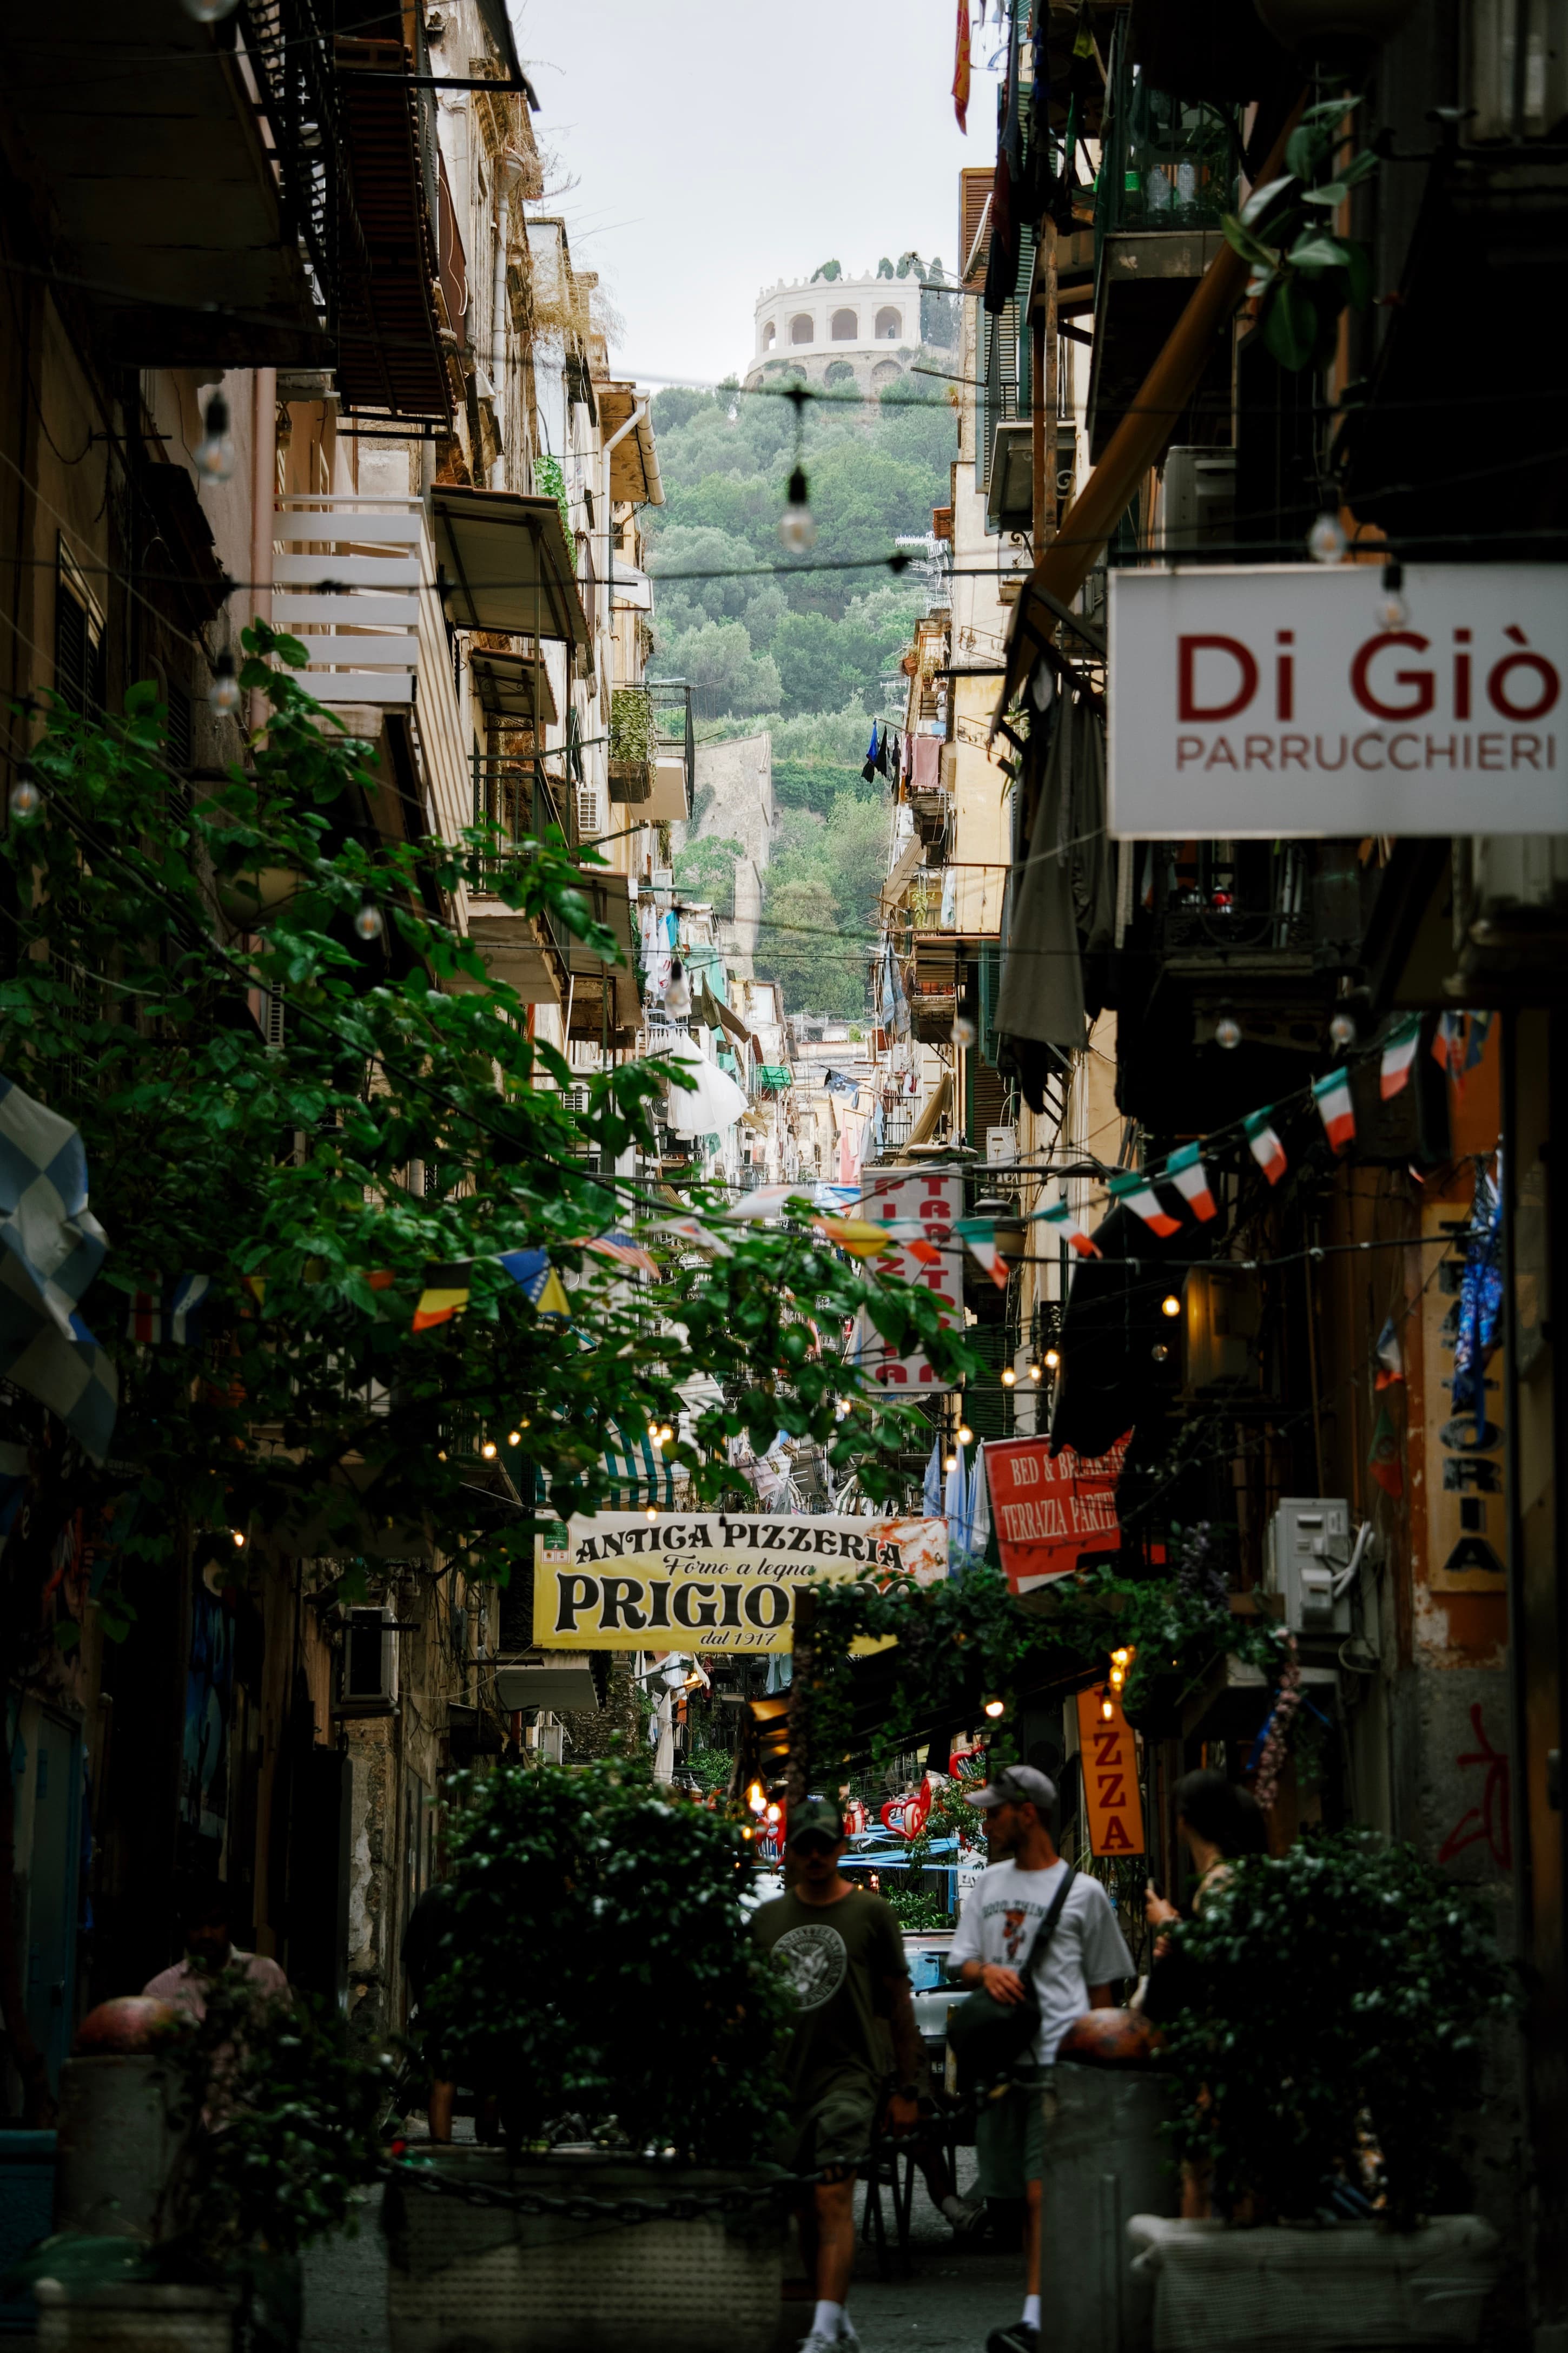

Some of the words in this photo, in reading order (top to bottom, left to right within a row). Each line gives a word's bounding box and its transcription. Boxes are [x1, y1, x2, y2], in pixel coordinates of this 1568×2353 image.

[1177, 630, 1294, 722] Di
[1350, 624, 1560, 721] Giò
[1176, 733, 1556, 772] PARRUCCHIERI
[1010, 1455, 1039, 1486] BED
[1043, 1454, 1056, 1482] &
[1001, 1498, 1068, 1542] TERRAZZA
[576, 1523, 713, 1565] ANTICA
[725, 1523, 905, 1571] PIZZERIA
[663, 1553, 733, 1576] Forno
[736, 1562, 752, 1575] a
[756, 1557, 816, 1583] legna
[700, 1630, 730, 1645] dal
[733, 1632, 777, 1646] 1917
